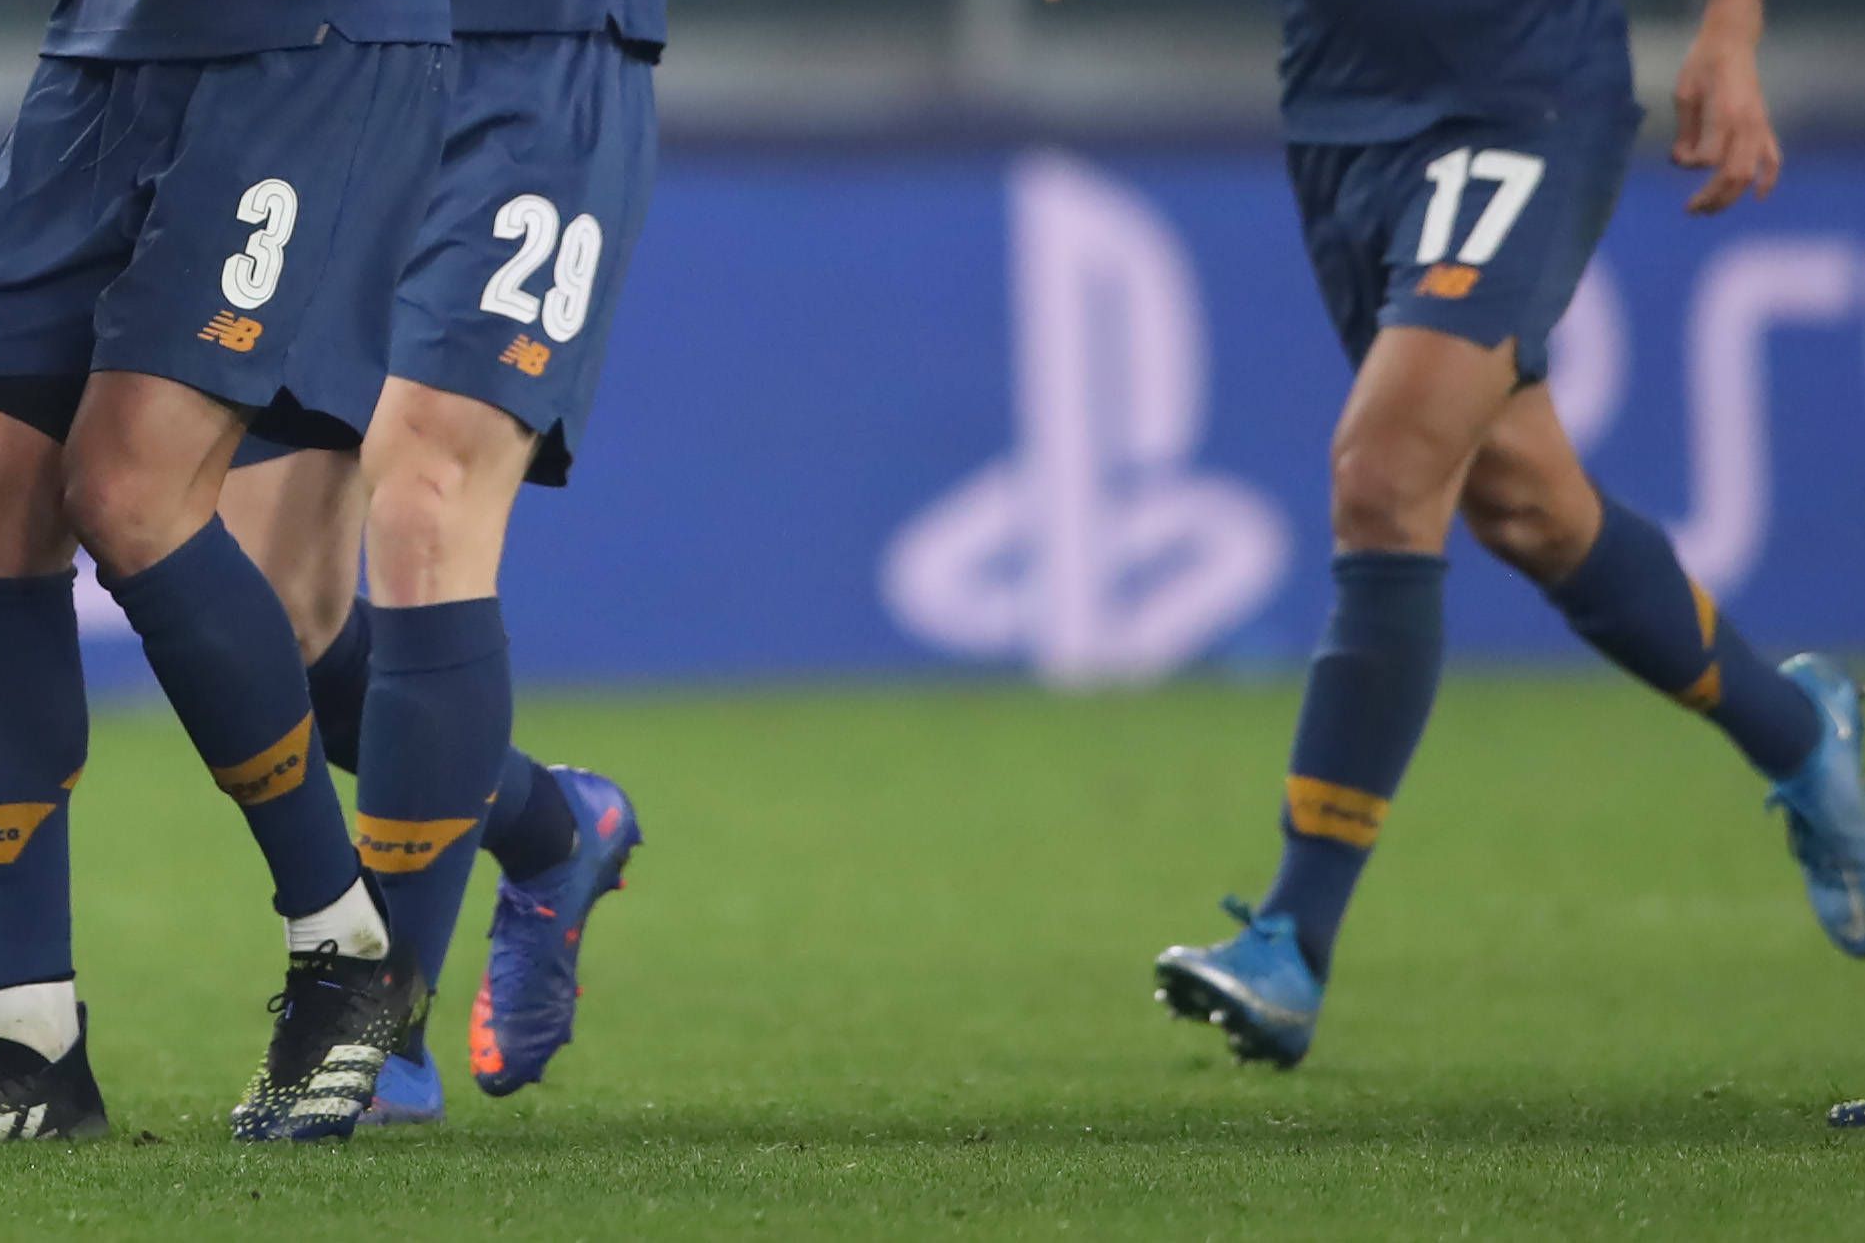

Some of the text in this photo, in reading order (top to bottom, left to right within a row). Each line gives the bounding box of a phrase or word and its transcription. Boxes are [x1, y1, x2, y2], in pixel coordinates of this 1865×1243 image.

[221, 178, 299, 311] 3
[480, 193, 603, 343] 29
[1415, 145, 1547, 266] 17
